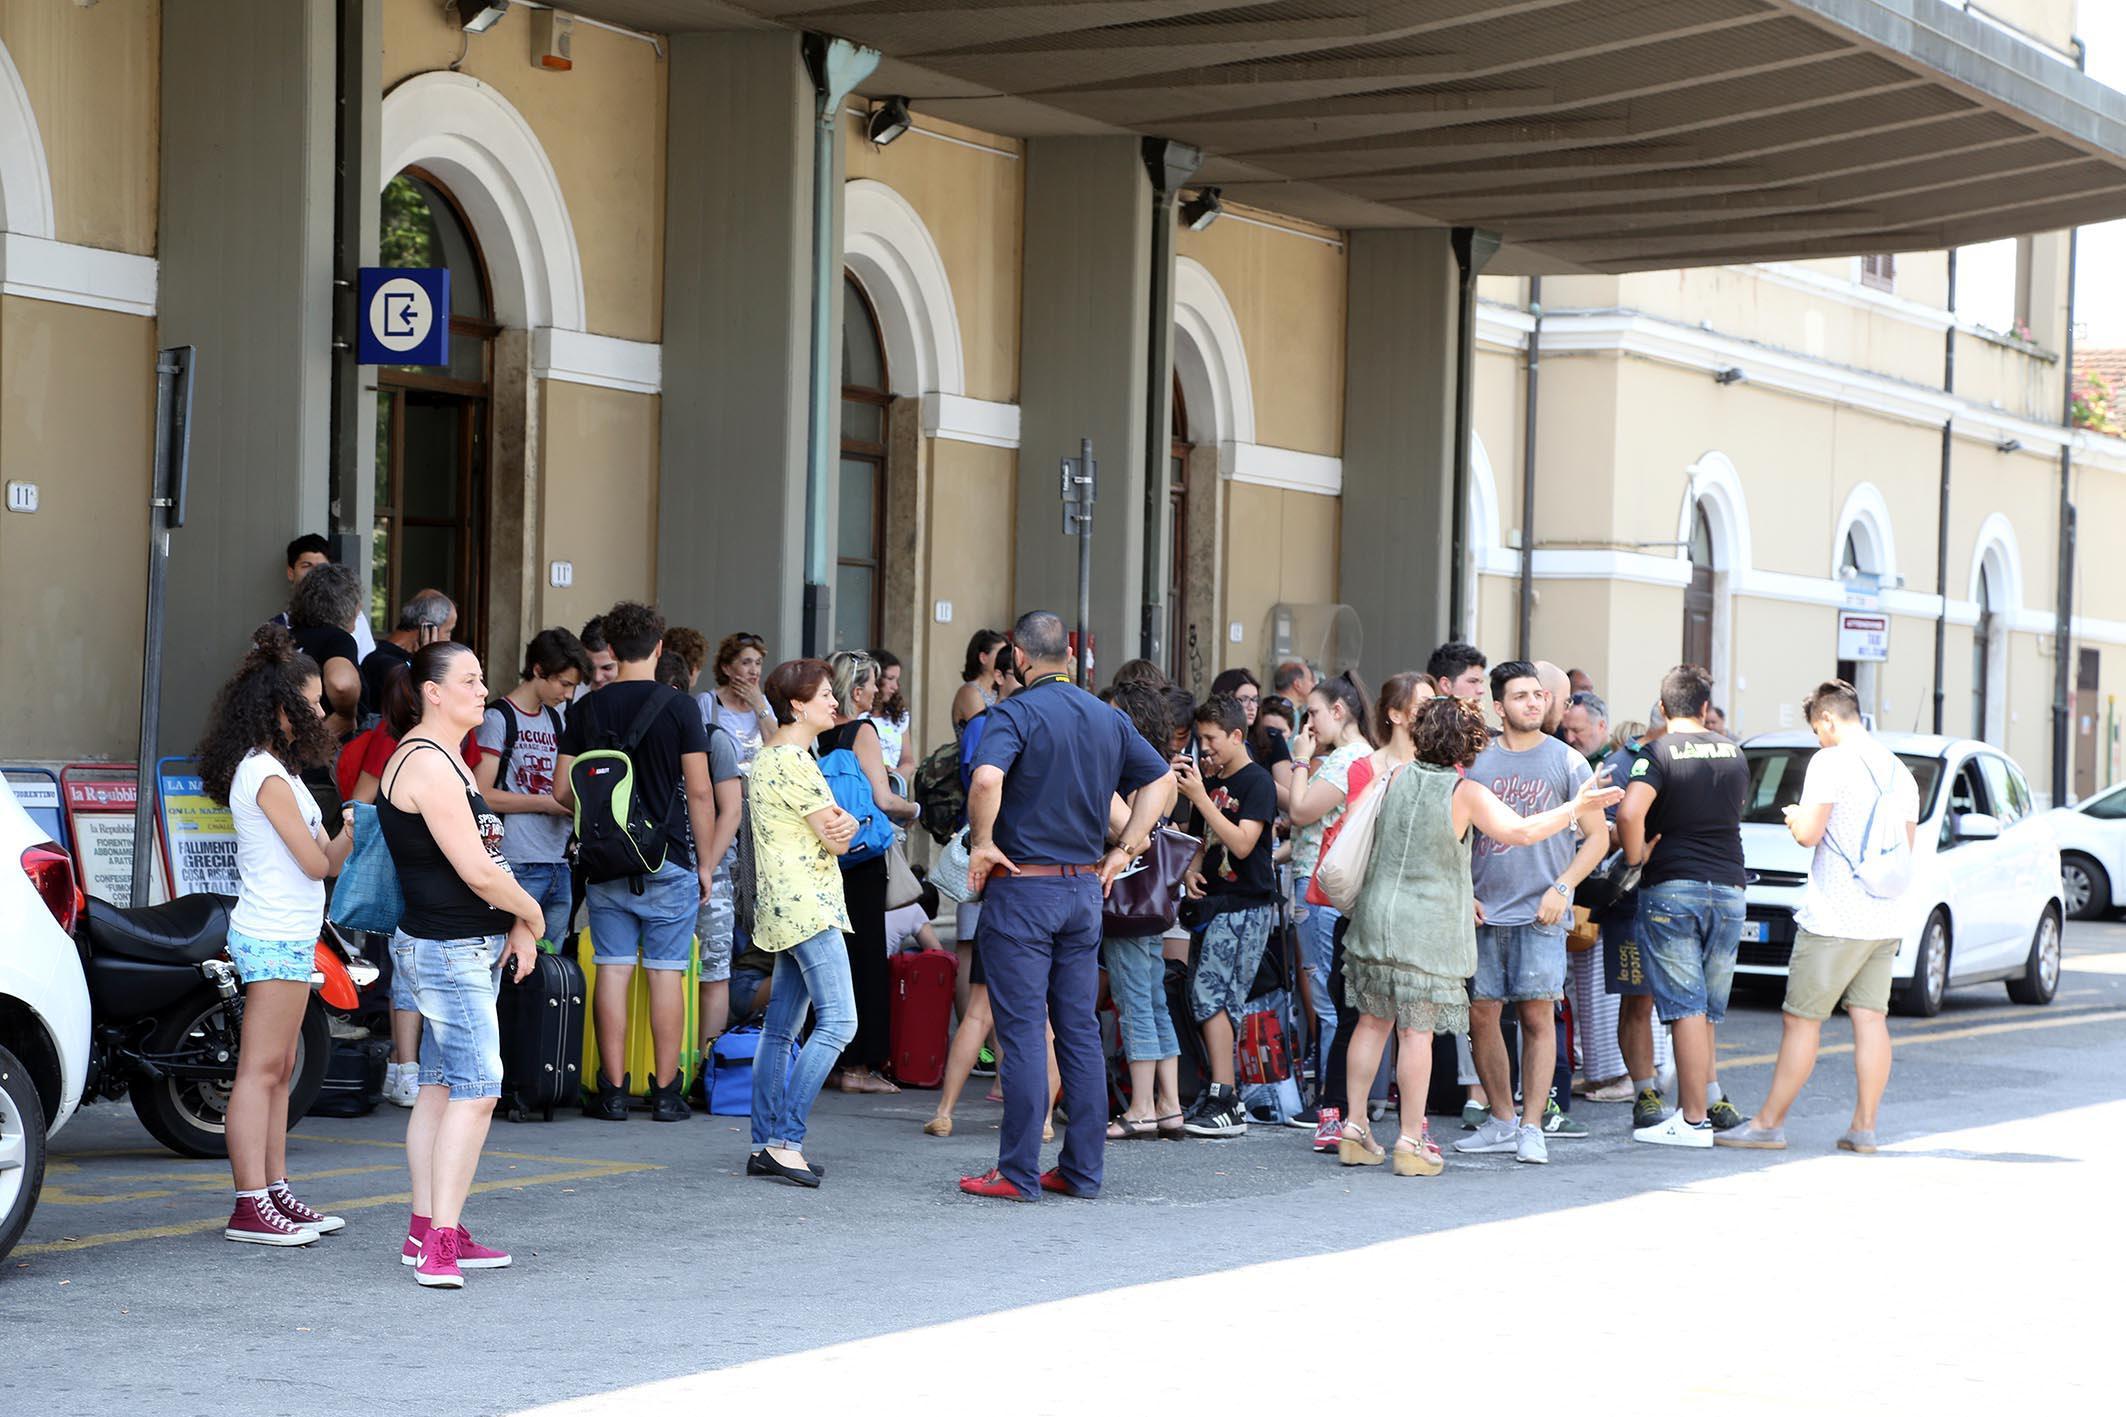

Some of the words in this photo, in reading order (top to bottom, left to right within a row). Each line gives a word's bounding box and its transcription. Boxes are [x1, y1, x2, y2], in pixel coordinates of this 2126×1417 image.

[167, 780, 184, 790] LA
[71, 786, 84, 801] la
[96, 839, 134, 847] FIORENTIN
[178, 841, 238, 854] FALLIMENTO
[94, 848, 133, 856] ABBONAME
[183, 855, 237, 867] GRECIA
[95, 874, 132, 883] CONFESER
[182, 868, 206, 881] COSA
[207, 868, 243, 881] RISCHIA
[189, 881, 239, 893] L'ITALIA
